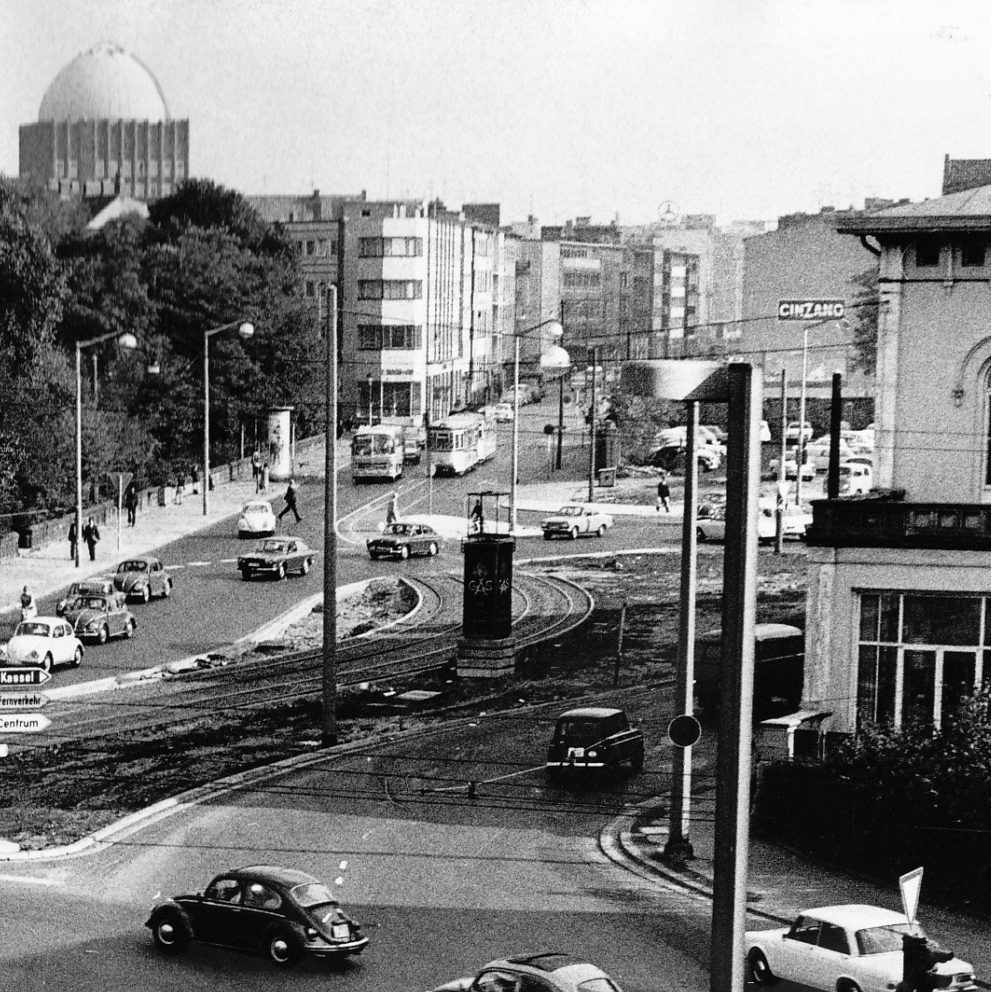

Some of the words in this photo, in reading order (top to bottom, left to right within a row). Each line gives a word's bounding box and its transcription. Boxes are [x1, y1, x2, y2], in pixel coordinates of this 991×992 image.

[779, 302, 845, 318] CINZANO
[468, 578, 493, 596] GAS
[0, 671, 34, 683] Kassel
